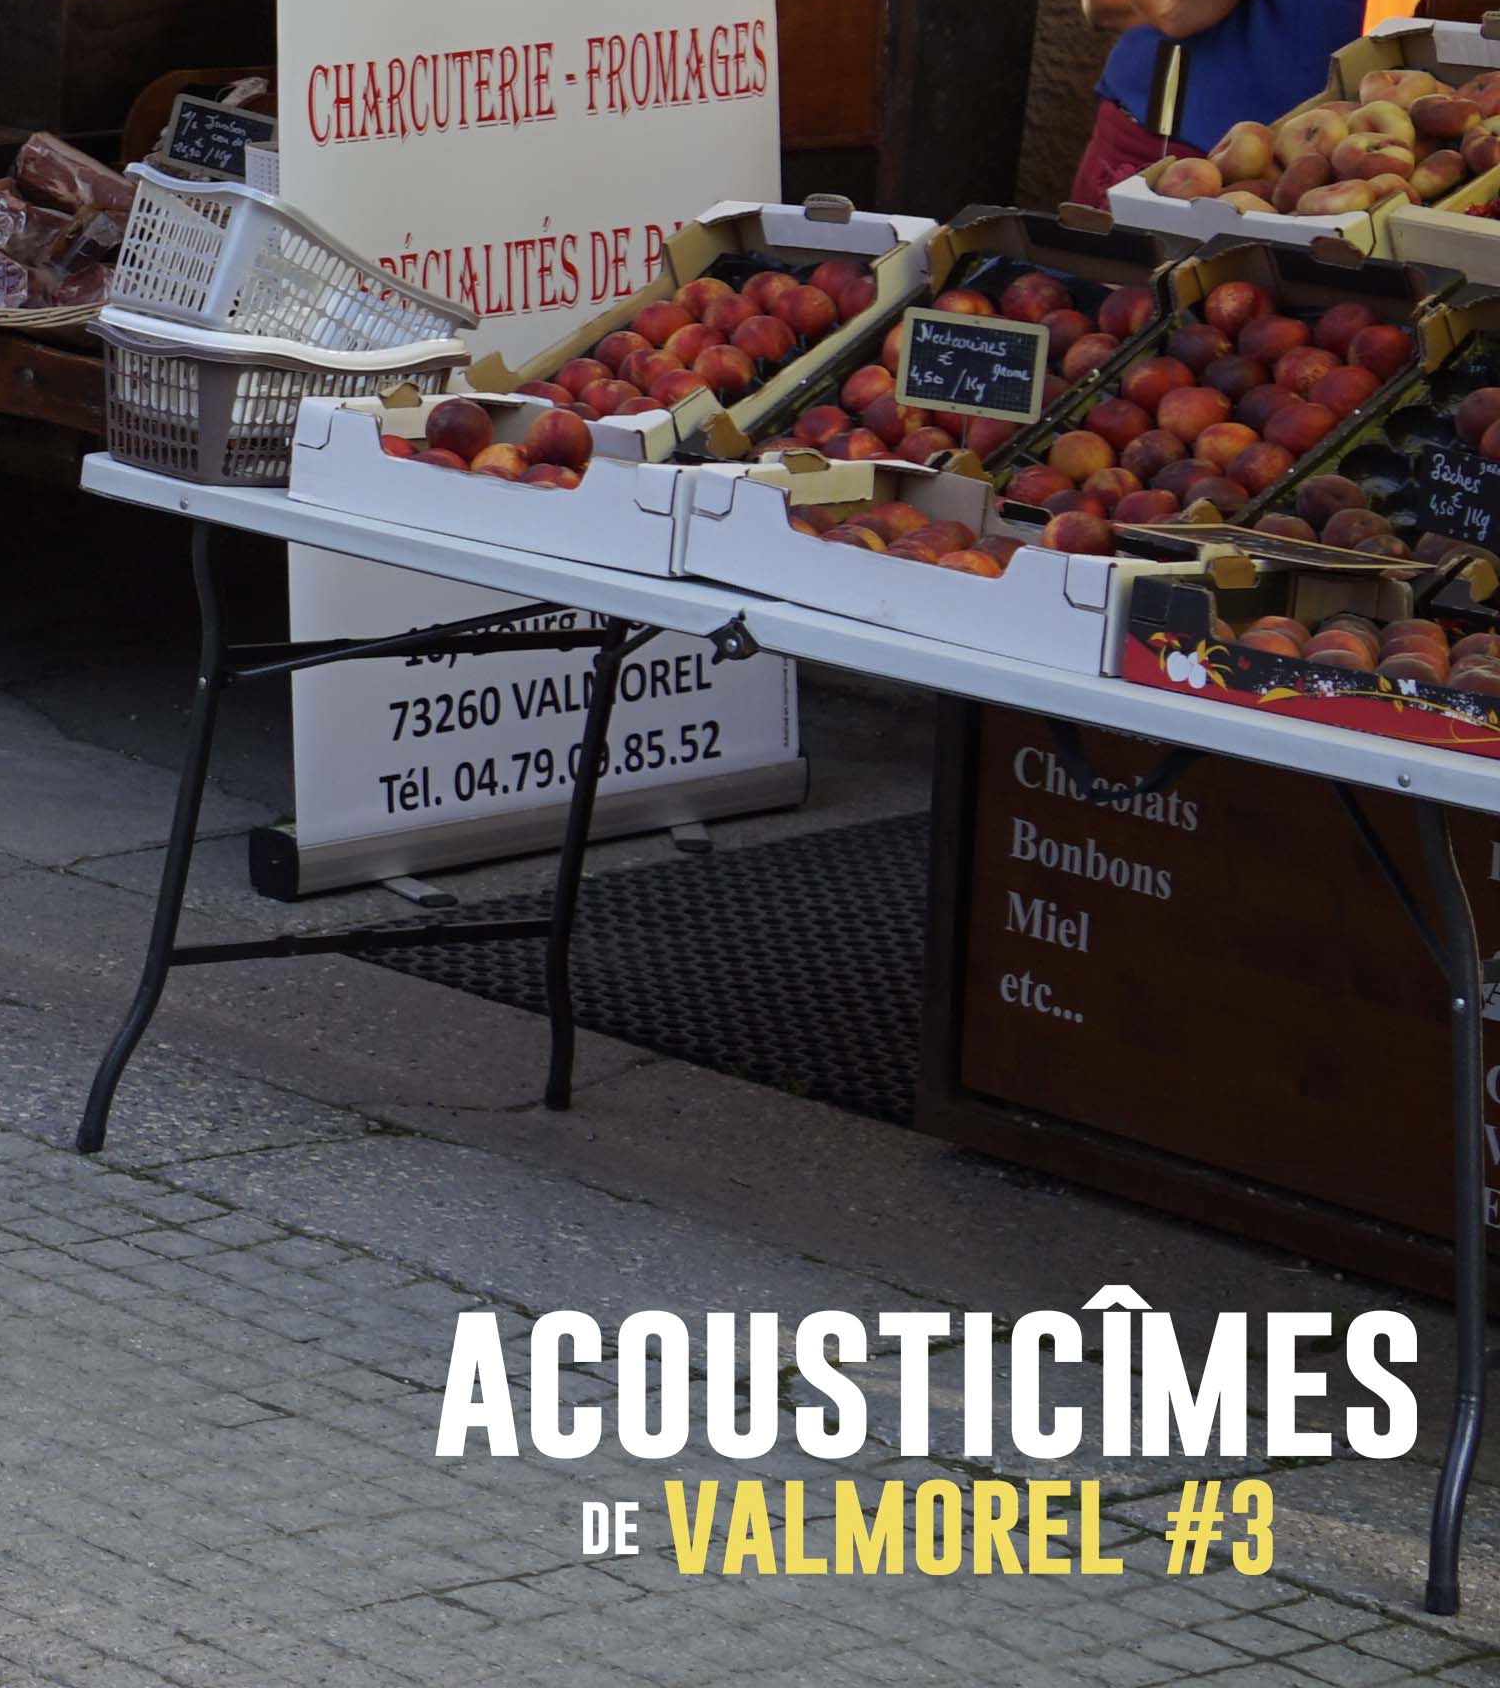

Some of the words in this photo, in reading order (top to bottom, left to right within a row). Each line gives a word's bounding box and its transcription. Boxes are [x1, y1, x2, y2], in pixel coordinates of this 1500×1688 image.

[307, 41, 558, 147] CHARCUTERIE
[586, 18, 769, 118] FROMAGES
[358, 215, 580, 320] PÉCIALITÉS
[589, 226, 632, 305] DE
[915, 320, 1008, 358] Nectarines
[909, 364, 946, 388] 4,50
[389, 686, 501, 742] 73260
[379, 766, 443, 814] Tél.
[1010, 816, 1173, 901] Bonbons
[1004, 890, 1091, 953] Miel
[1000, 968, 1084, 1024] etc...
